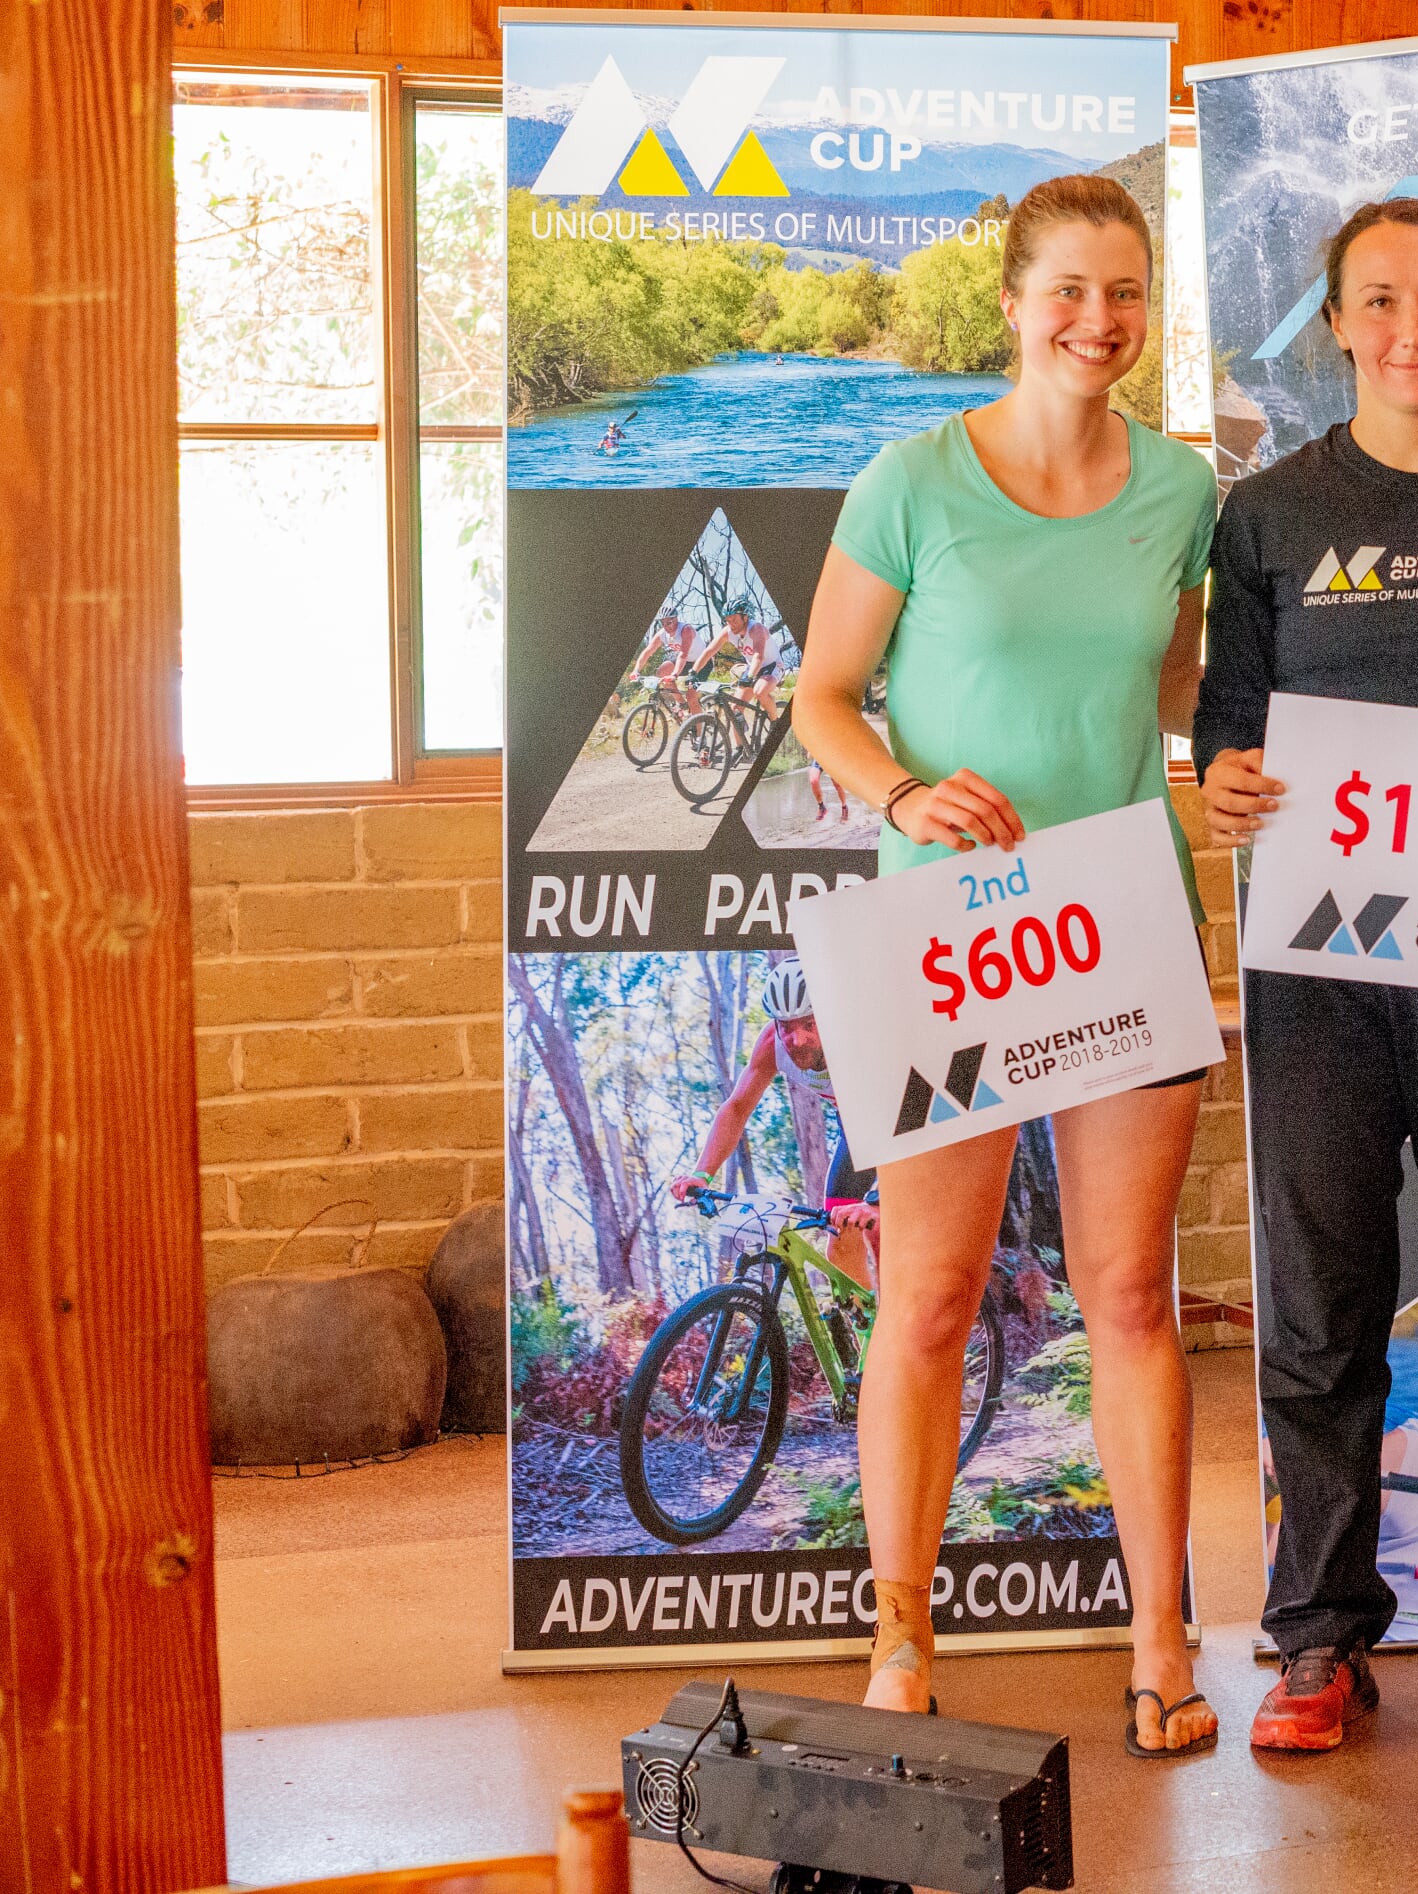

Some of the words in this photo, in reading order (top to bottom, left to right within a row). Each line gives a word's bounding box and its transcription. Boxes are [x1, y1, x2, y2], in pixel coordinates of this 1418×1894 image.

[810, 86, 1136, 134] ADVENTURE
[810, 131, 922, 172] CUP
[531, 210, 655, 243] UNIQUE
[664, 211, 766, 241] SERIES
[774, 212, 817, 241] OF
[825, 214, 1011, 247] MULTISPOR
[1303, 593, 1340, 607] UNIQUE
[1341, 592, 1377, 604] SERIES
[1378, 590, 1395, 602] OF
[525, 874, 656, 937] RUN
[958, 857, 1031, 911] 2nd
[921, 903, 1102, 1022] $600
[1003, 1008, 1148, 1066] ADVENTURE
[1007, 1057, 1057, 1085] CUP
[1060, 1029, 1153, 1072] 2018-2019
[540, 1558, 1129, 1634] ADVENTURECP.COM.A
